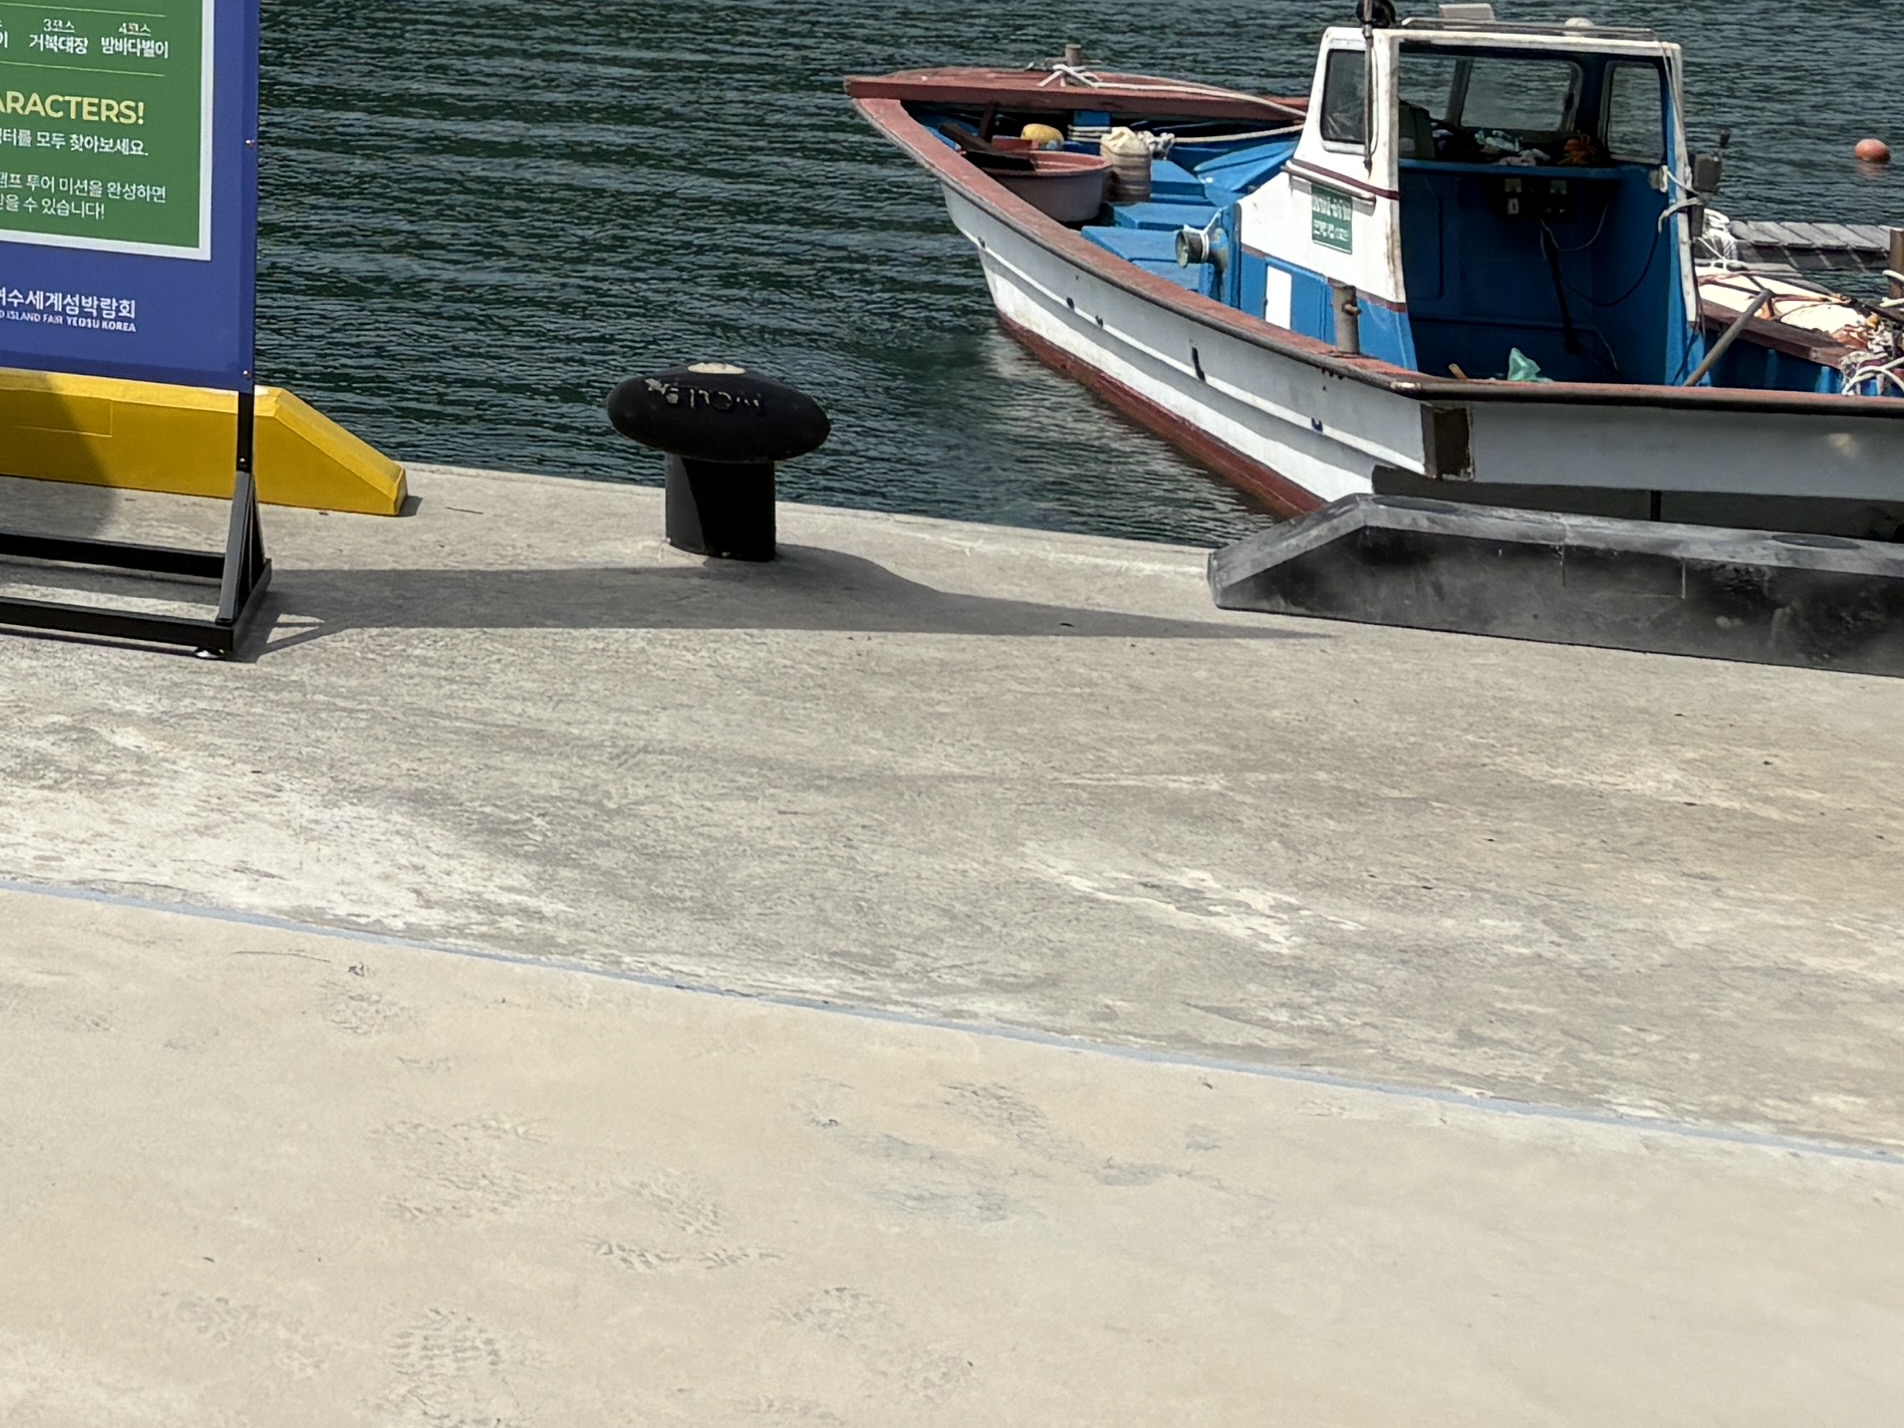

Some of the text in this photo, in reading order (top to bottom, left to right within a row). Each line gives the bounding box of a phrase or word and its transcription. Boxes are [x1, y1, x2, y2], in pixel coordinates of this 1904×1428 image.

[36, 132, 66, 150] 모두
[26, 174, 55, 193] 투어
[59, 178, 103, 197] 미션을
[107, 182, 166, 203] 완성하면
[23, 197, 38, 213] 수
[42, 198, 105, 220] 있습니다!
[7, 311, 41, 323] ISLAND
[102, 320, 137, 332] KOREA
